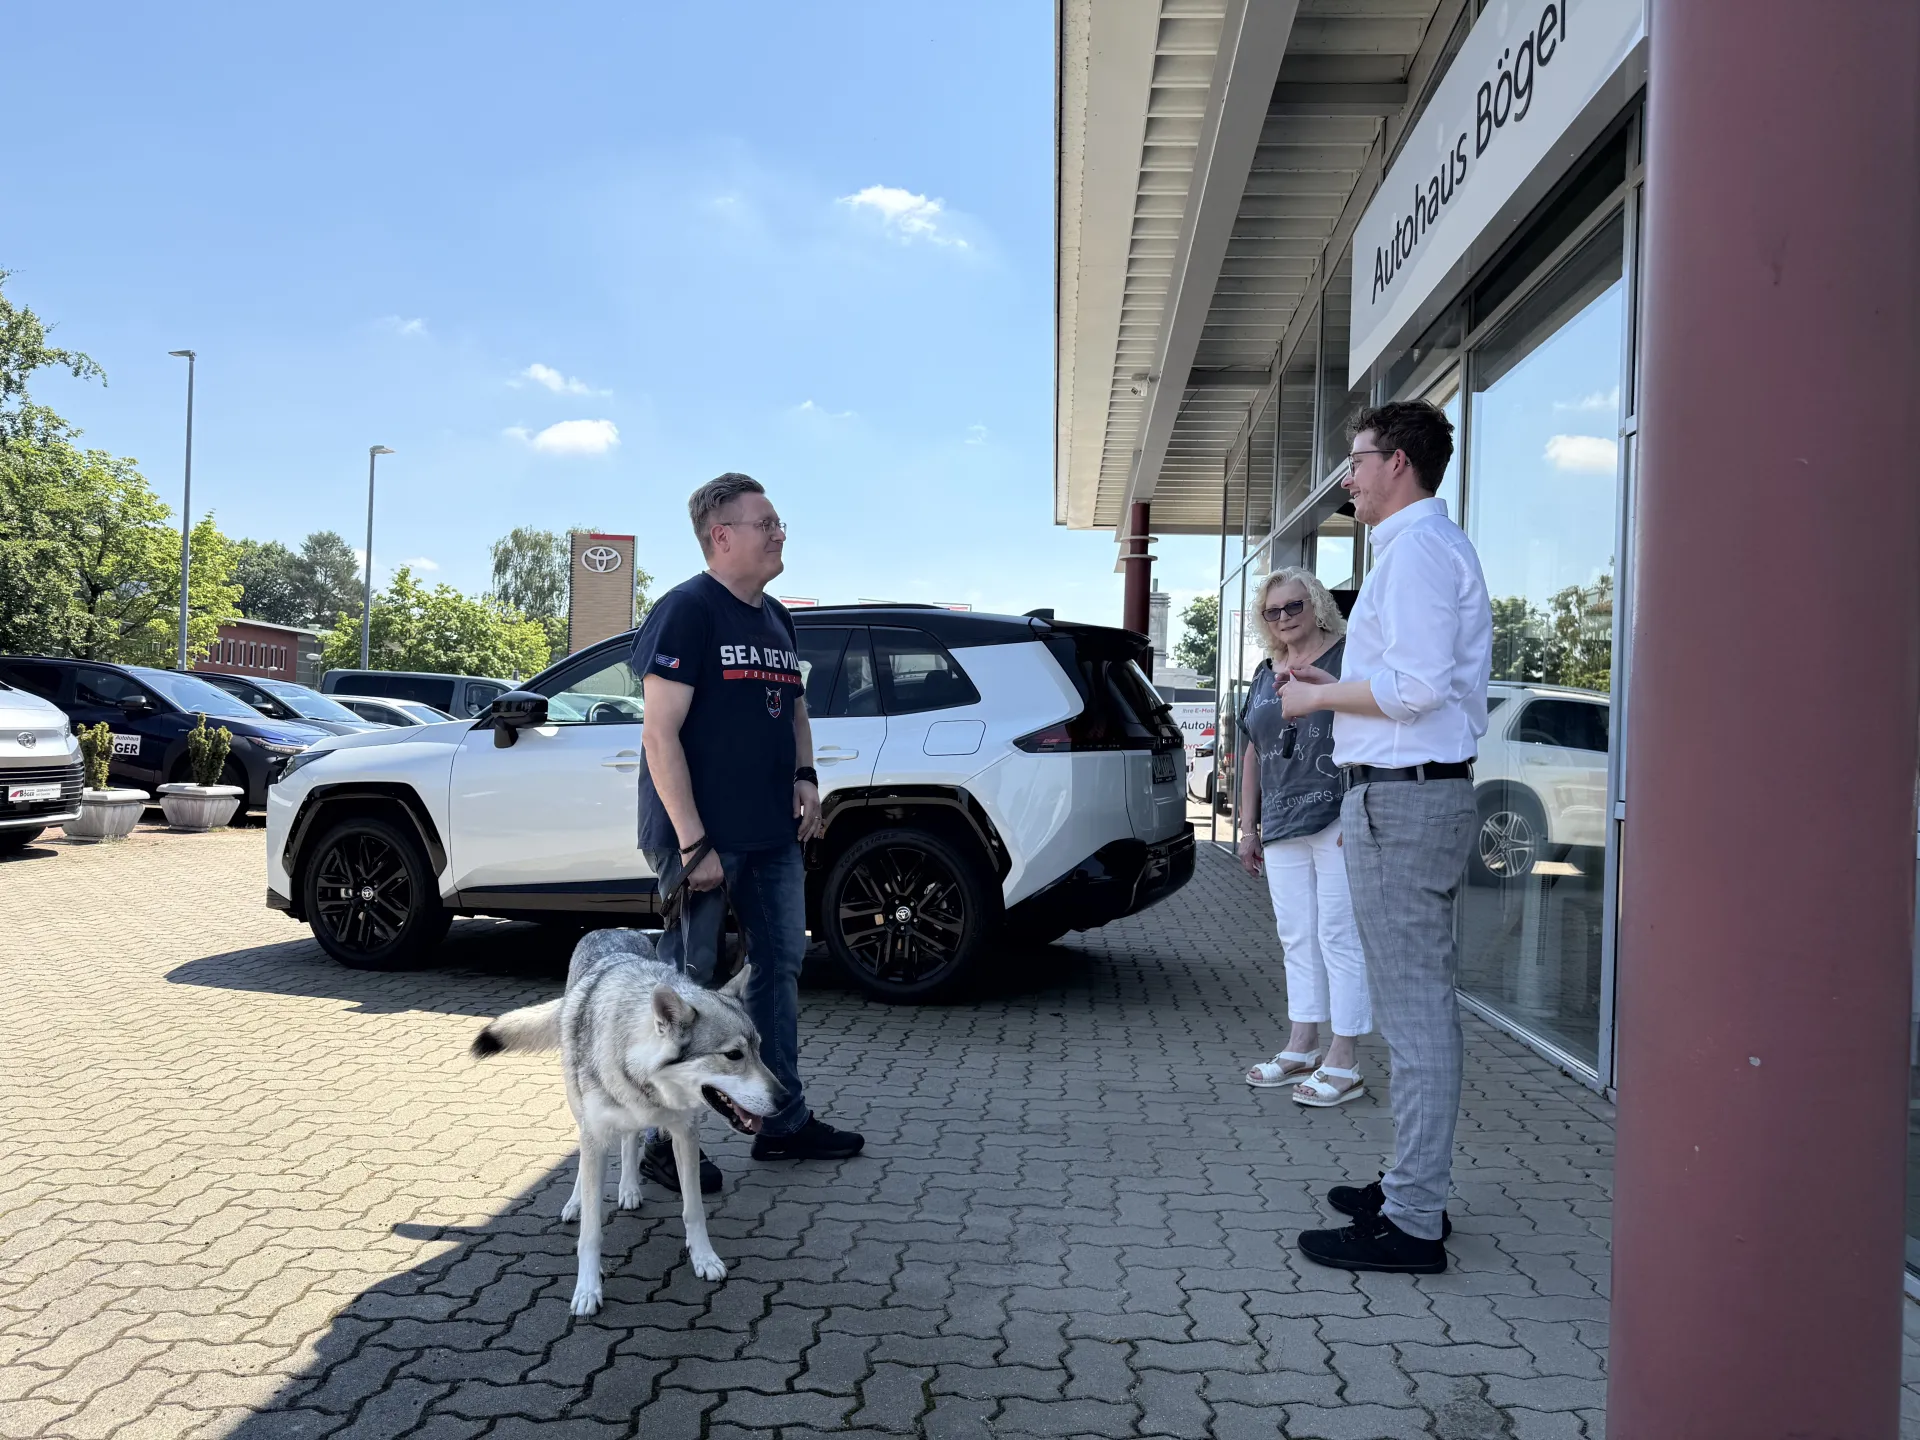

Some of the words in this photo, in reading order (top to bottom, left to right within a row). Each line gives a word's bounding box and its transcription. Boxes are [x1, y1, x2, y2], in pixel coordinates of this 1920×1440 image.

[1372, 132, 1467, 305] Autohaus
[720, 645, 762, 666] SEA
[763, 648, 800, 671] DEVIL
[114, 742, 138, 754] GER
[1275, 790, 1334, 812] FLOWERS
